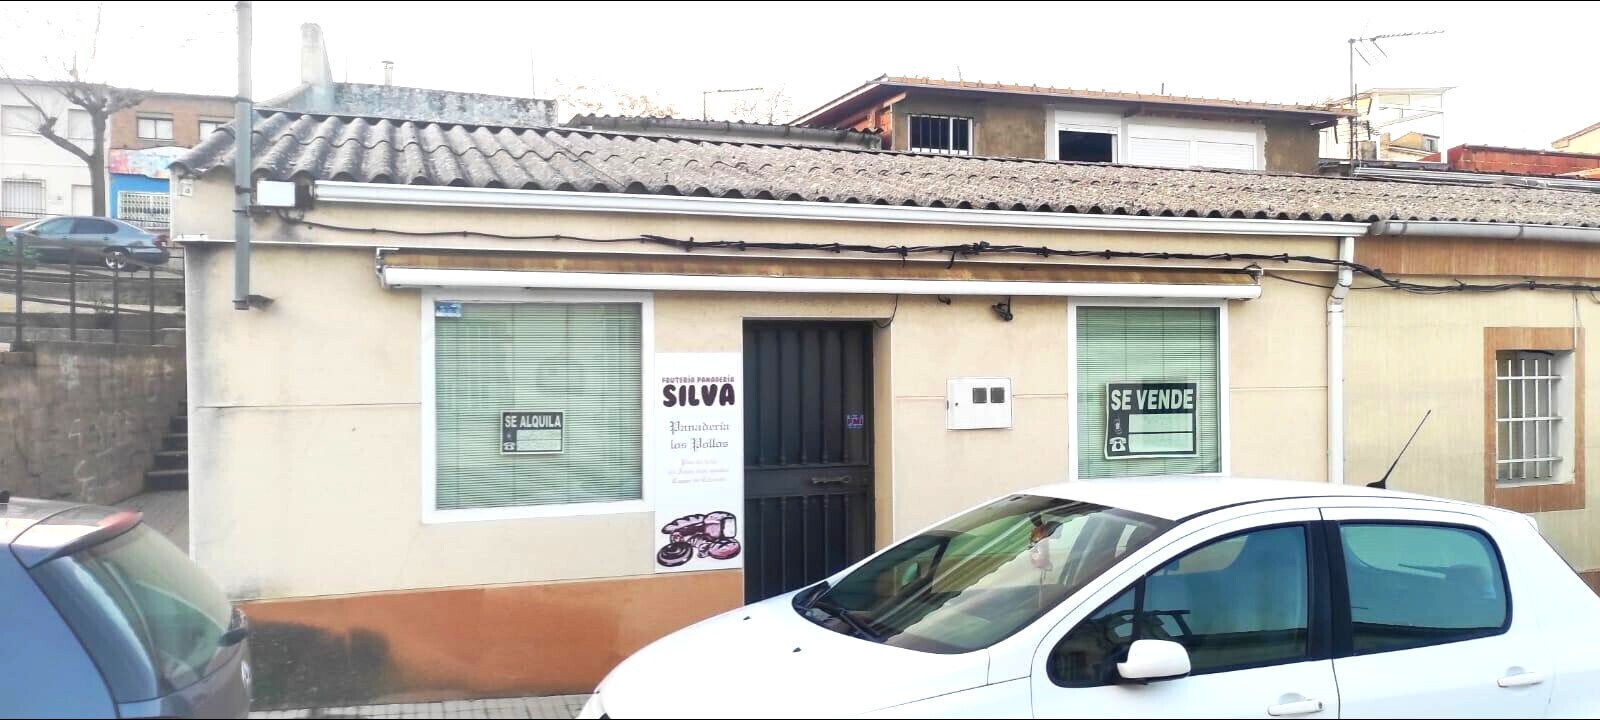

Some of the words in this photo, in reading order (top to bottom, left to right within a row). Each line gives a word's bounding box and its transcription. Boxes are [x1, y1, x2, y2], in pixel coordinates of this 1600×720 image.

[662, 383, 735, 407] SILVA
[1111, 389, 1132, 411] SE
[1136, 388, 1194, 410] VENDE
[504, 415, 517, 428] SE
[519, 415, 561, 428] ALQUILA
[669, 420, 729, 435] Panadería
